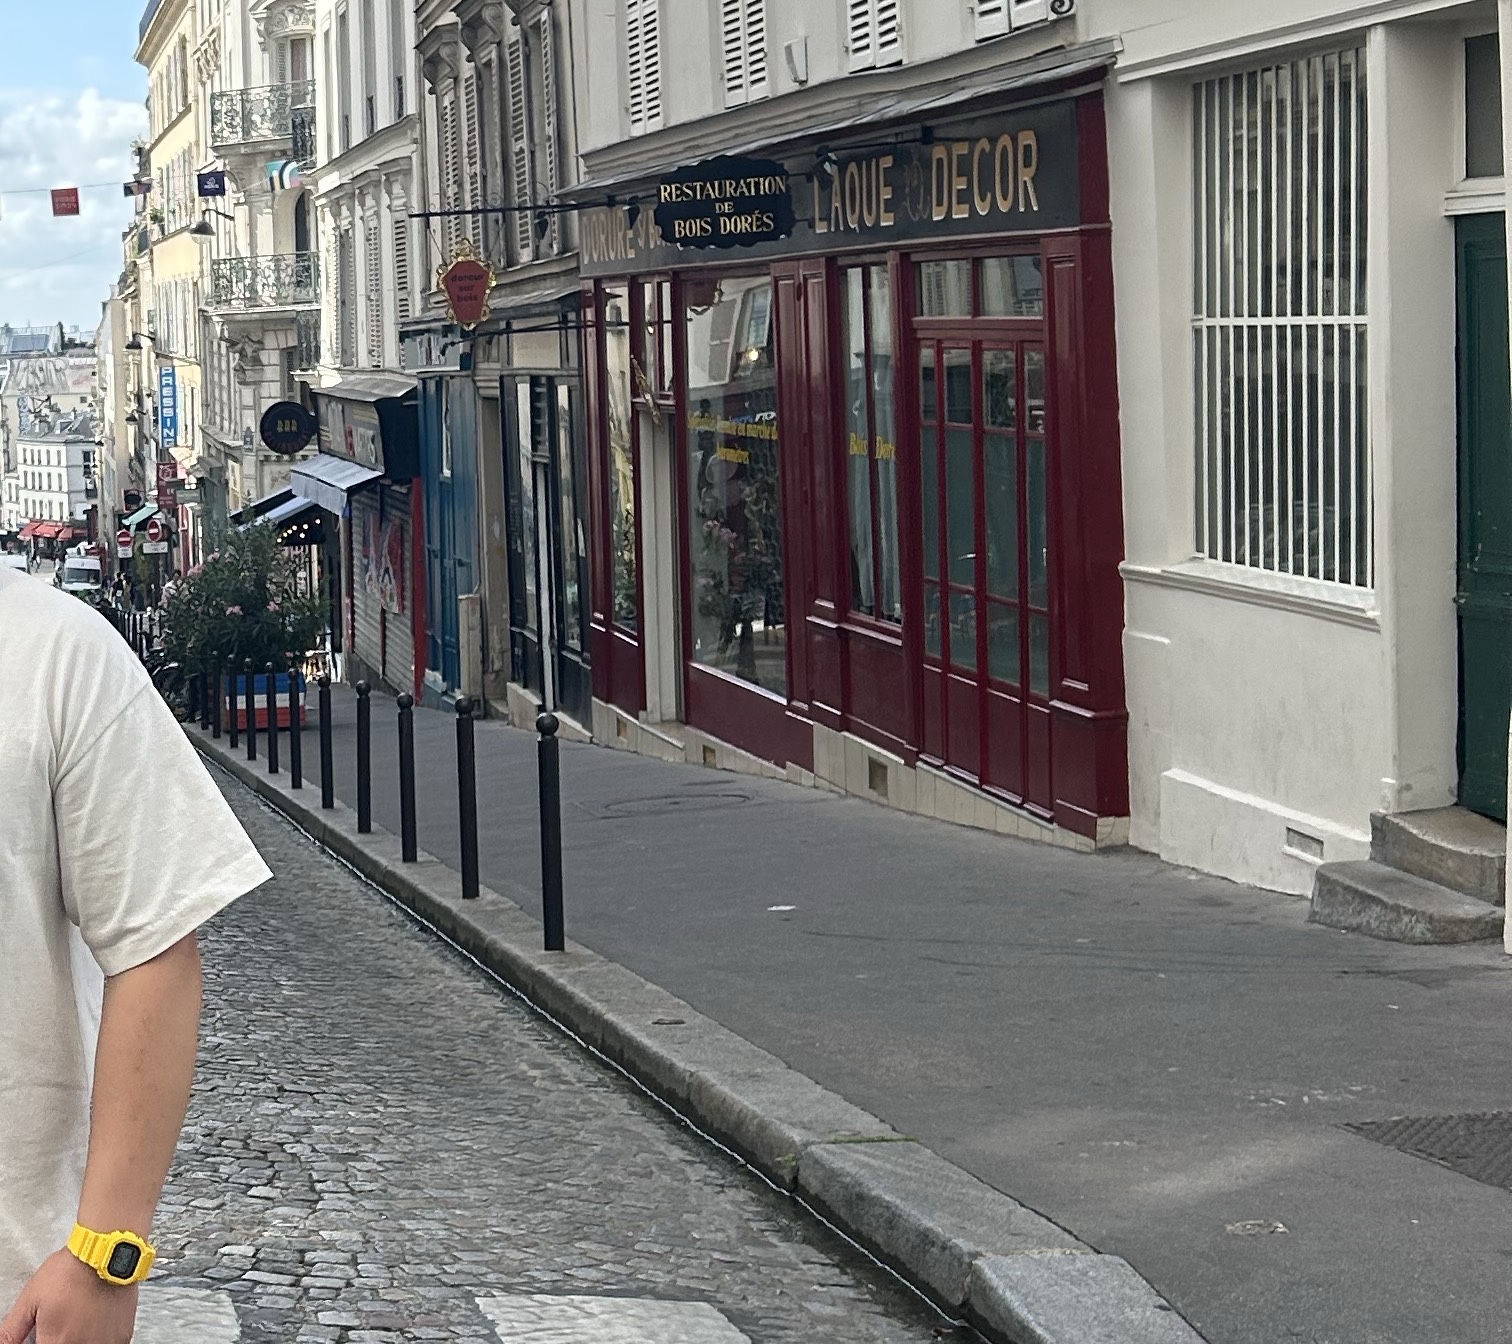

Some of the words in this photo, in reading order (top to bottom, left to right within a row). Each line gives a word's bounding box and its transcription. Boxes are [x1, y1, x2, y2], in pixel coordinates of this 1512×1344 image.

[660, 175, 787, 204] RESTAURATION
[931, 130, 1040, 222] DECOR
[715, 202, 735, 214] DE
[674, 217, 713, 239] BOIS
[719, 209, 775, 235] DORÉS
[456, 294, 478, 303] bois
[458, 284, 475, 292] sur
[161, 366, 175, 448] PRESSING
